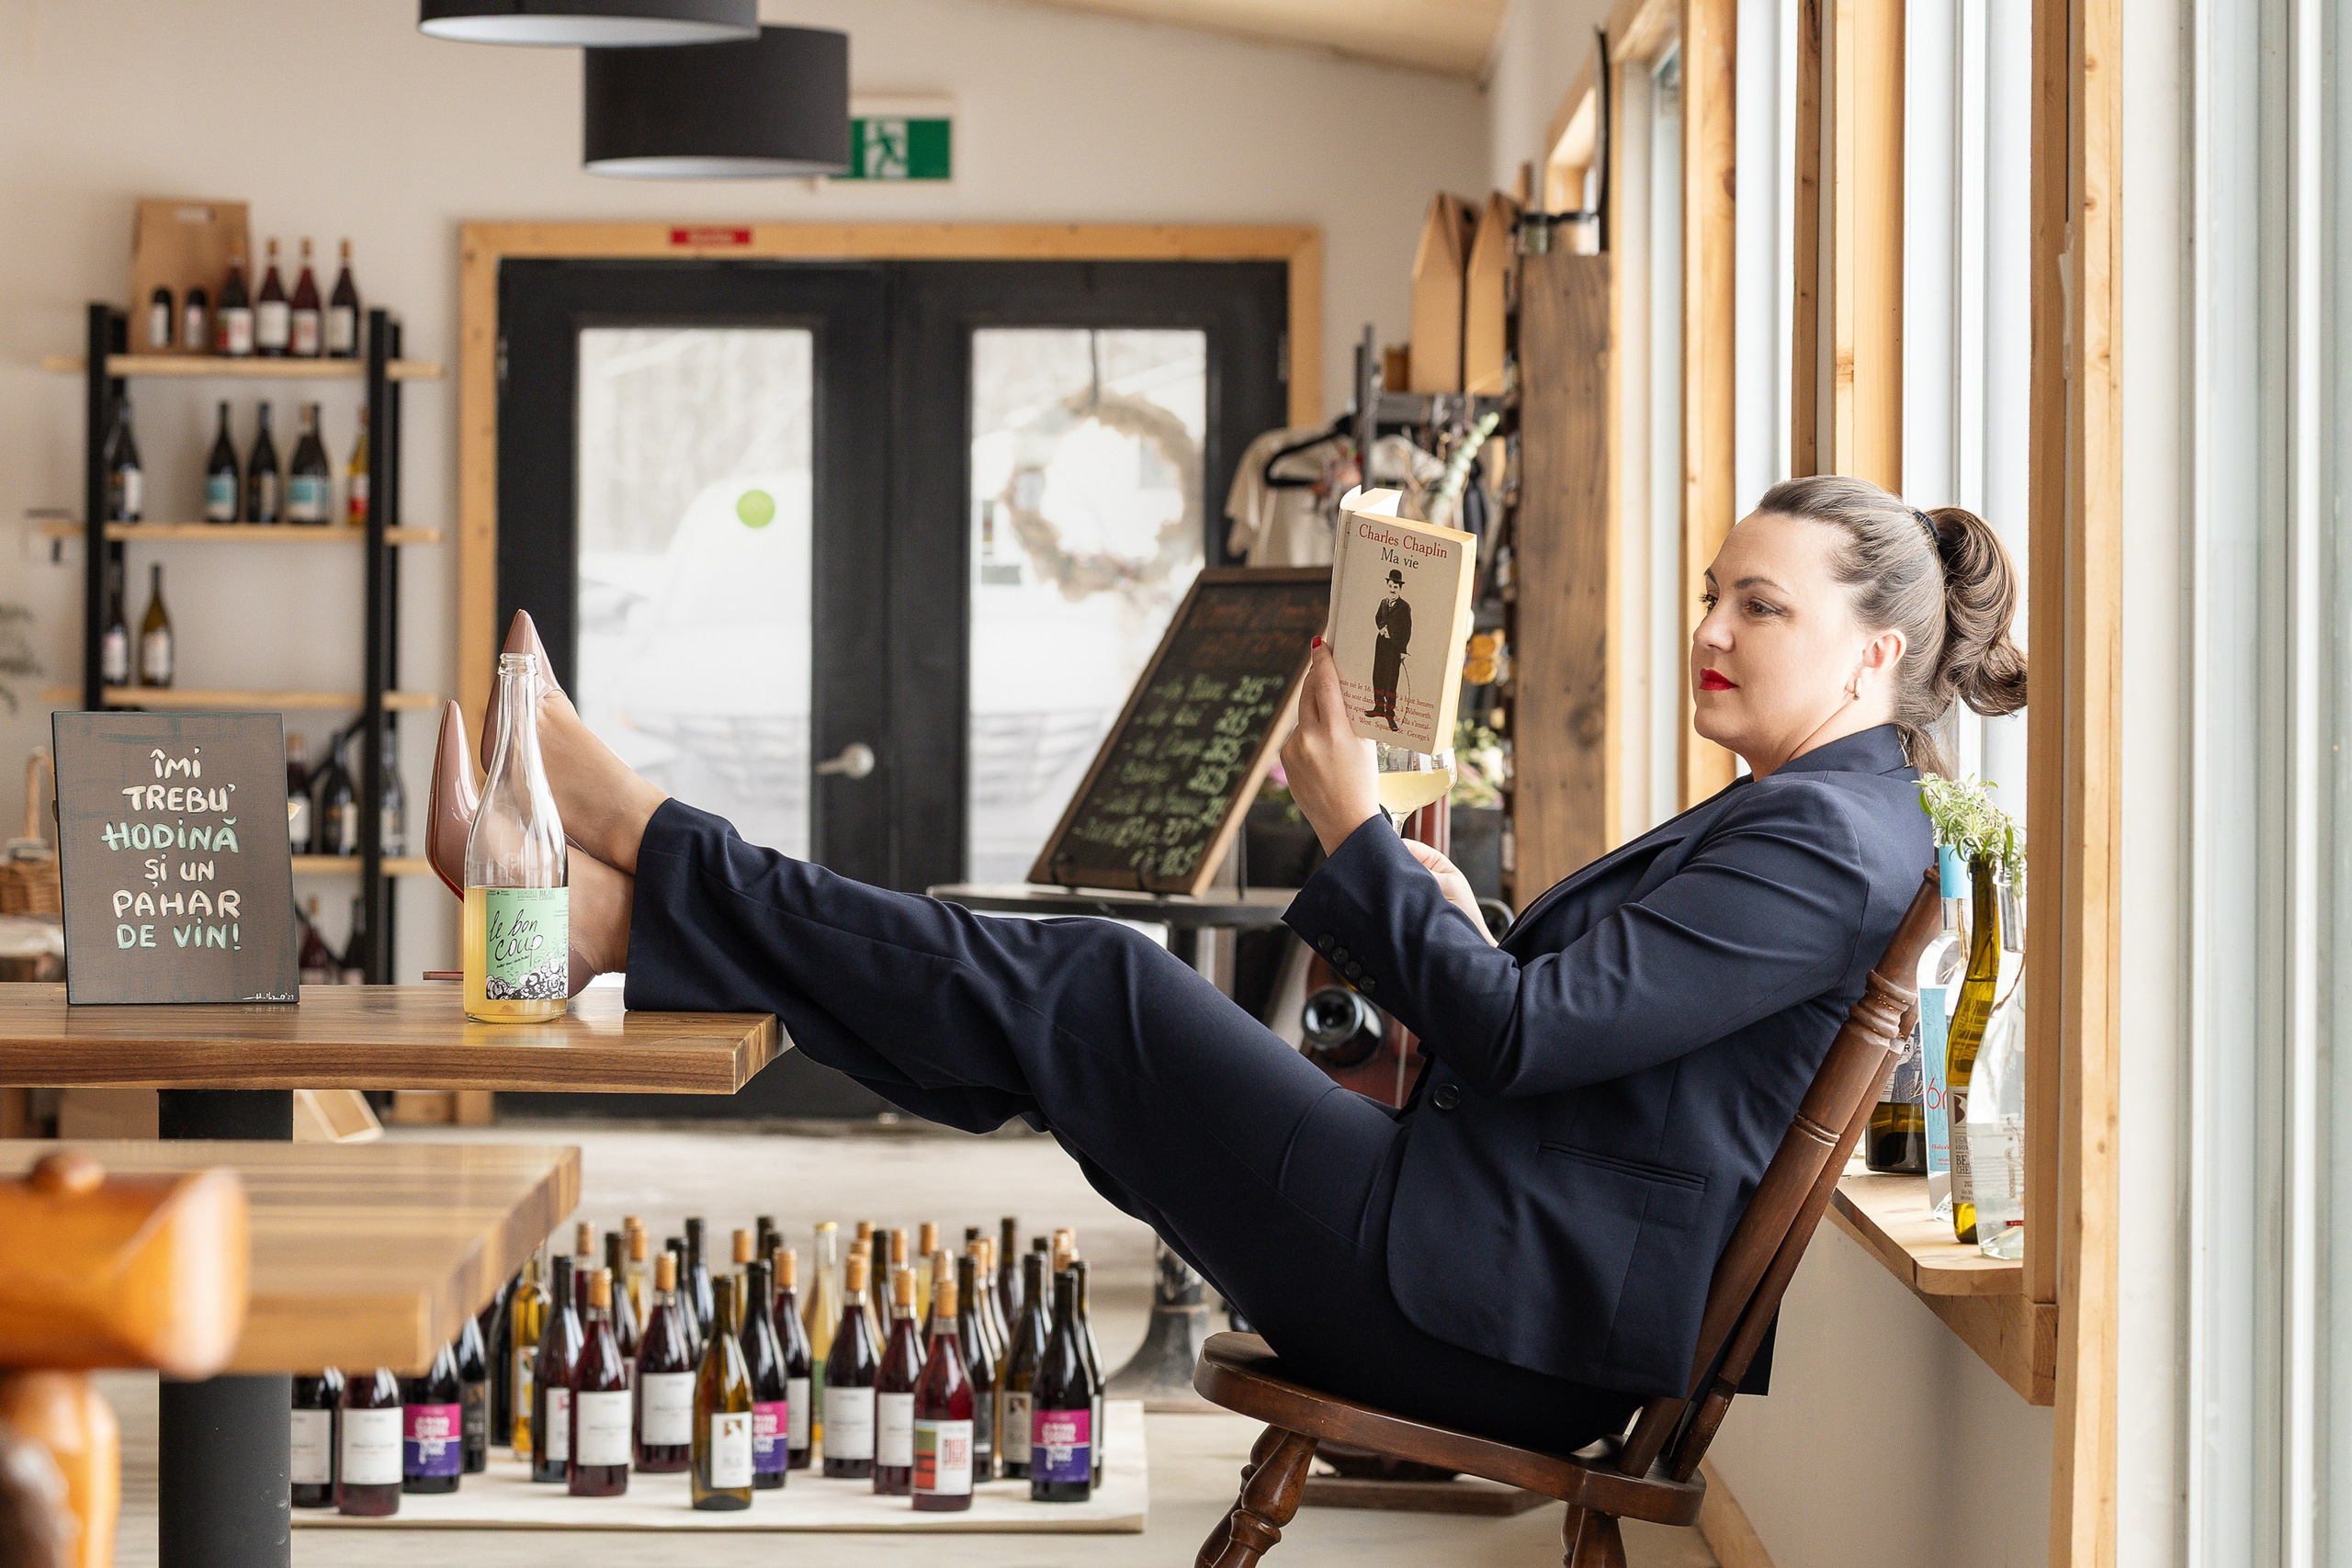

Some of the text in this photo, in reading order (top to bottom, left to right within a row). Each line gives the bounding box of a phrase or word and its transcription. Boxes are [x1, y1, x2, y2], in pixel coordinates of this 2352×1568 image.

[1359, 524, 1448, 558] Charles Chaplin
[1381, 547, 1419, 570] Ma vie
[1363, 695, 1374, 705] dans
[1417, 699, 1434, 709] heures
[1359, 716, 1372, 727] West
[1407, 729, 1430, 741] George's
[180, 860, 214, 882] UN
[112, 889, 241, 919] PAHAR
[116, 924, 157, 950] DE
[489, 908, 538, 942] le bon
